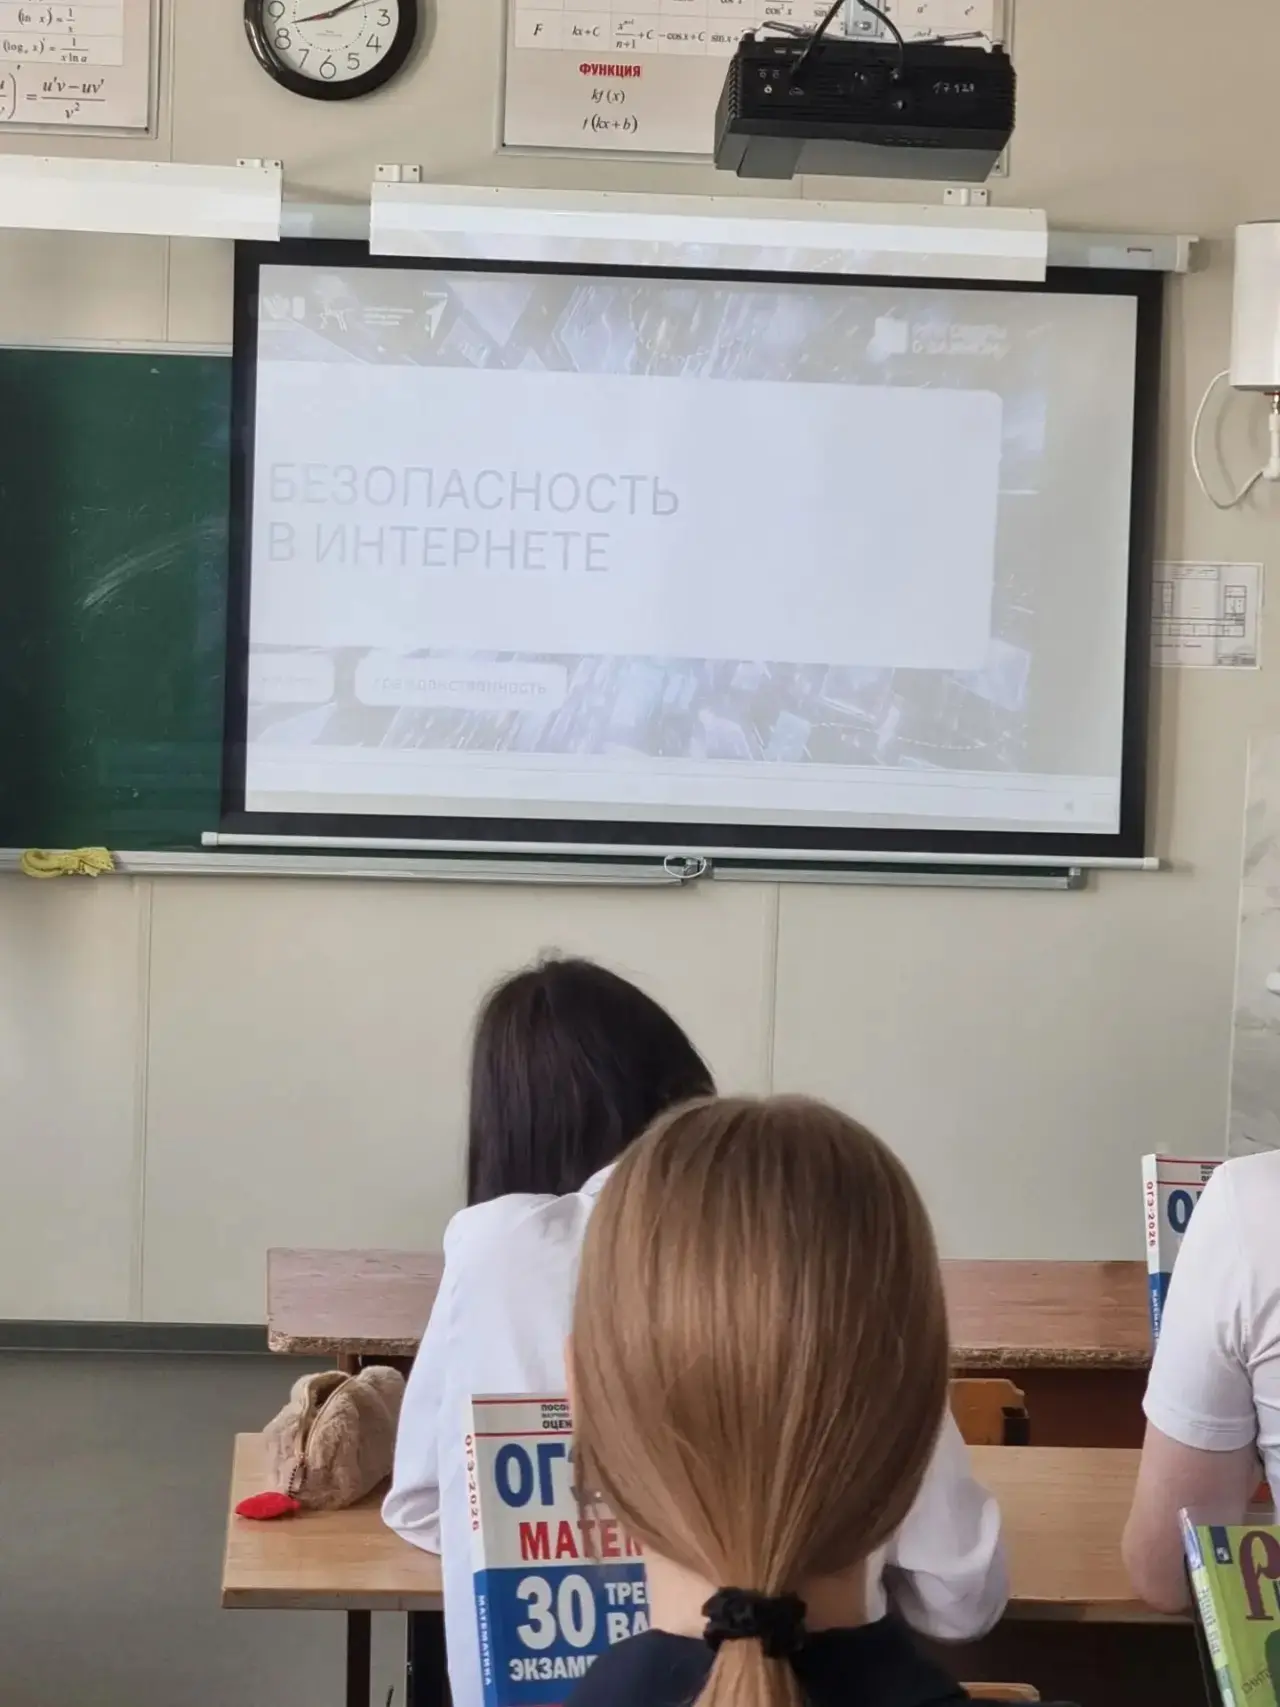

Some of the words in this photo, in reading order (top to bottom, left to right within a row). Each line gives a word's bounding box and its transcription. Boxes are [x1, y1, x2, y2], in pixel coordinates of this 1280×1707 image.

[268, 1, 285, 24] 9
[376, 8, 391, 27] 3
[274, 28, 291, 50] 8
[533, 23, 544, 37] F
[366, 33, 382, 54] 4
[298, 49, 310, 69] 7
[319, 55, 337, 79] 6
[346, 52, 360, 70] 5
[579, 63, 641, 78] ФУНКЦИЯ
[269, 462, 679, 516] БЕЗОПАСНОСТЬ
[268, 521, 296, 563] В
[316, 522, 611, 572] ИНТЕРНЕТЕ
[540, 1403, 569, 1412] ПОСО
[465, 1434, 480, 1531] ОГЭ-2026
[604, 1581, 650, 1605] ТРЕ
[516, 1574, 596, 1650] 30
[478, 1595, 492, 1686] МАТЕМАТИКА
